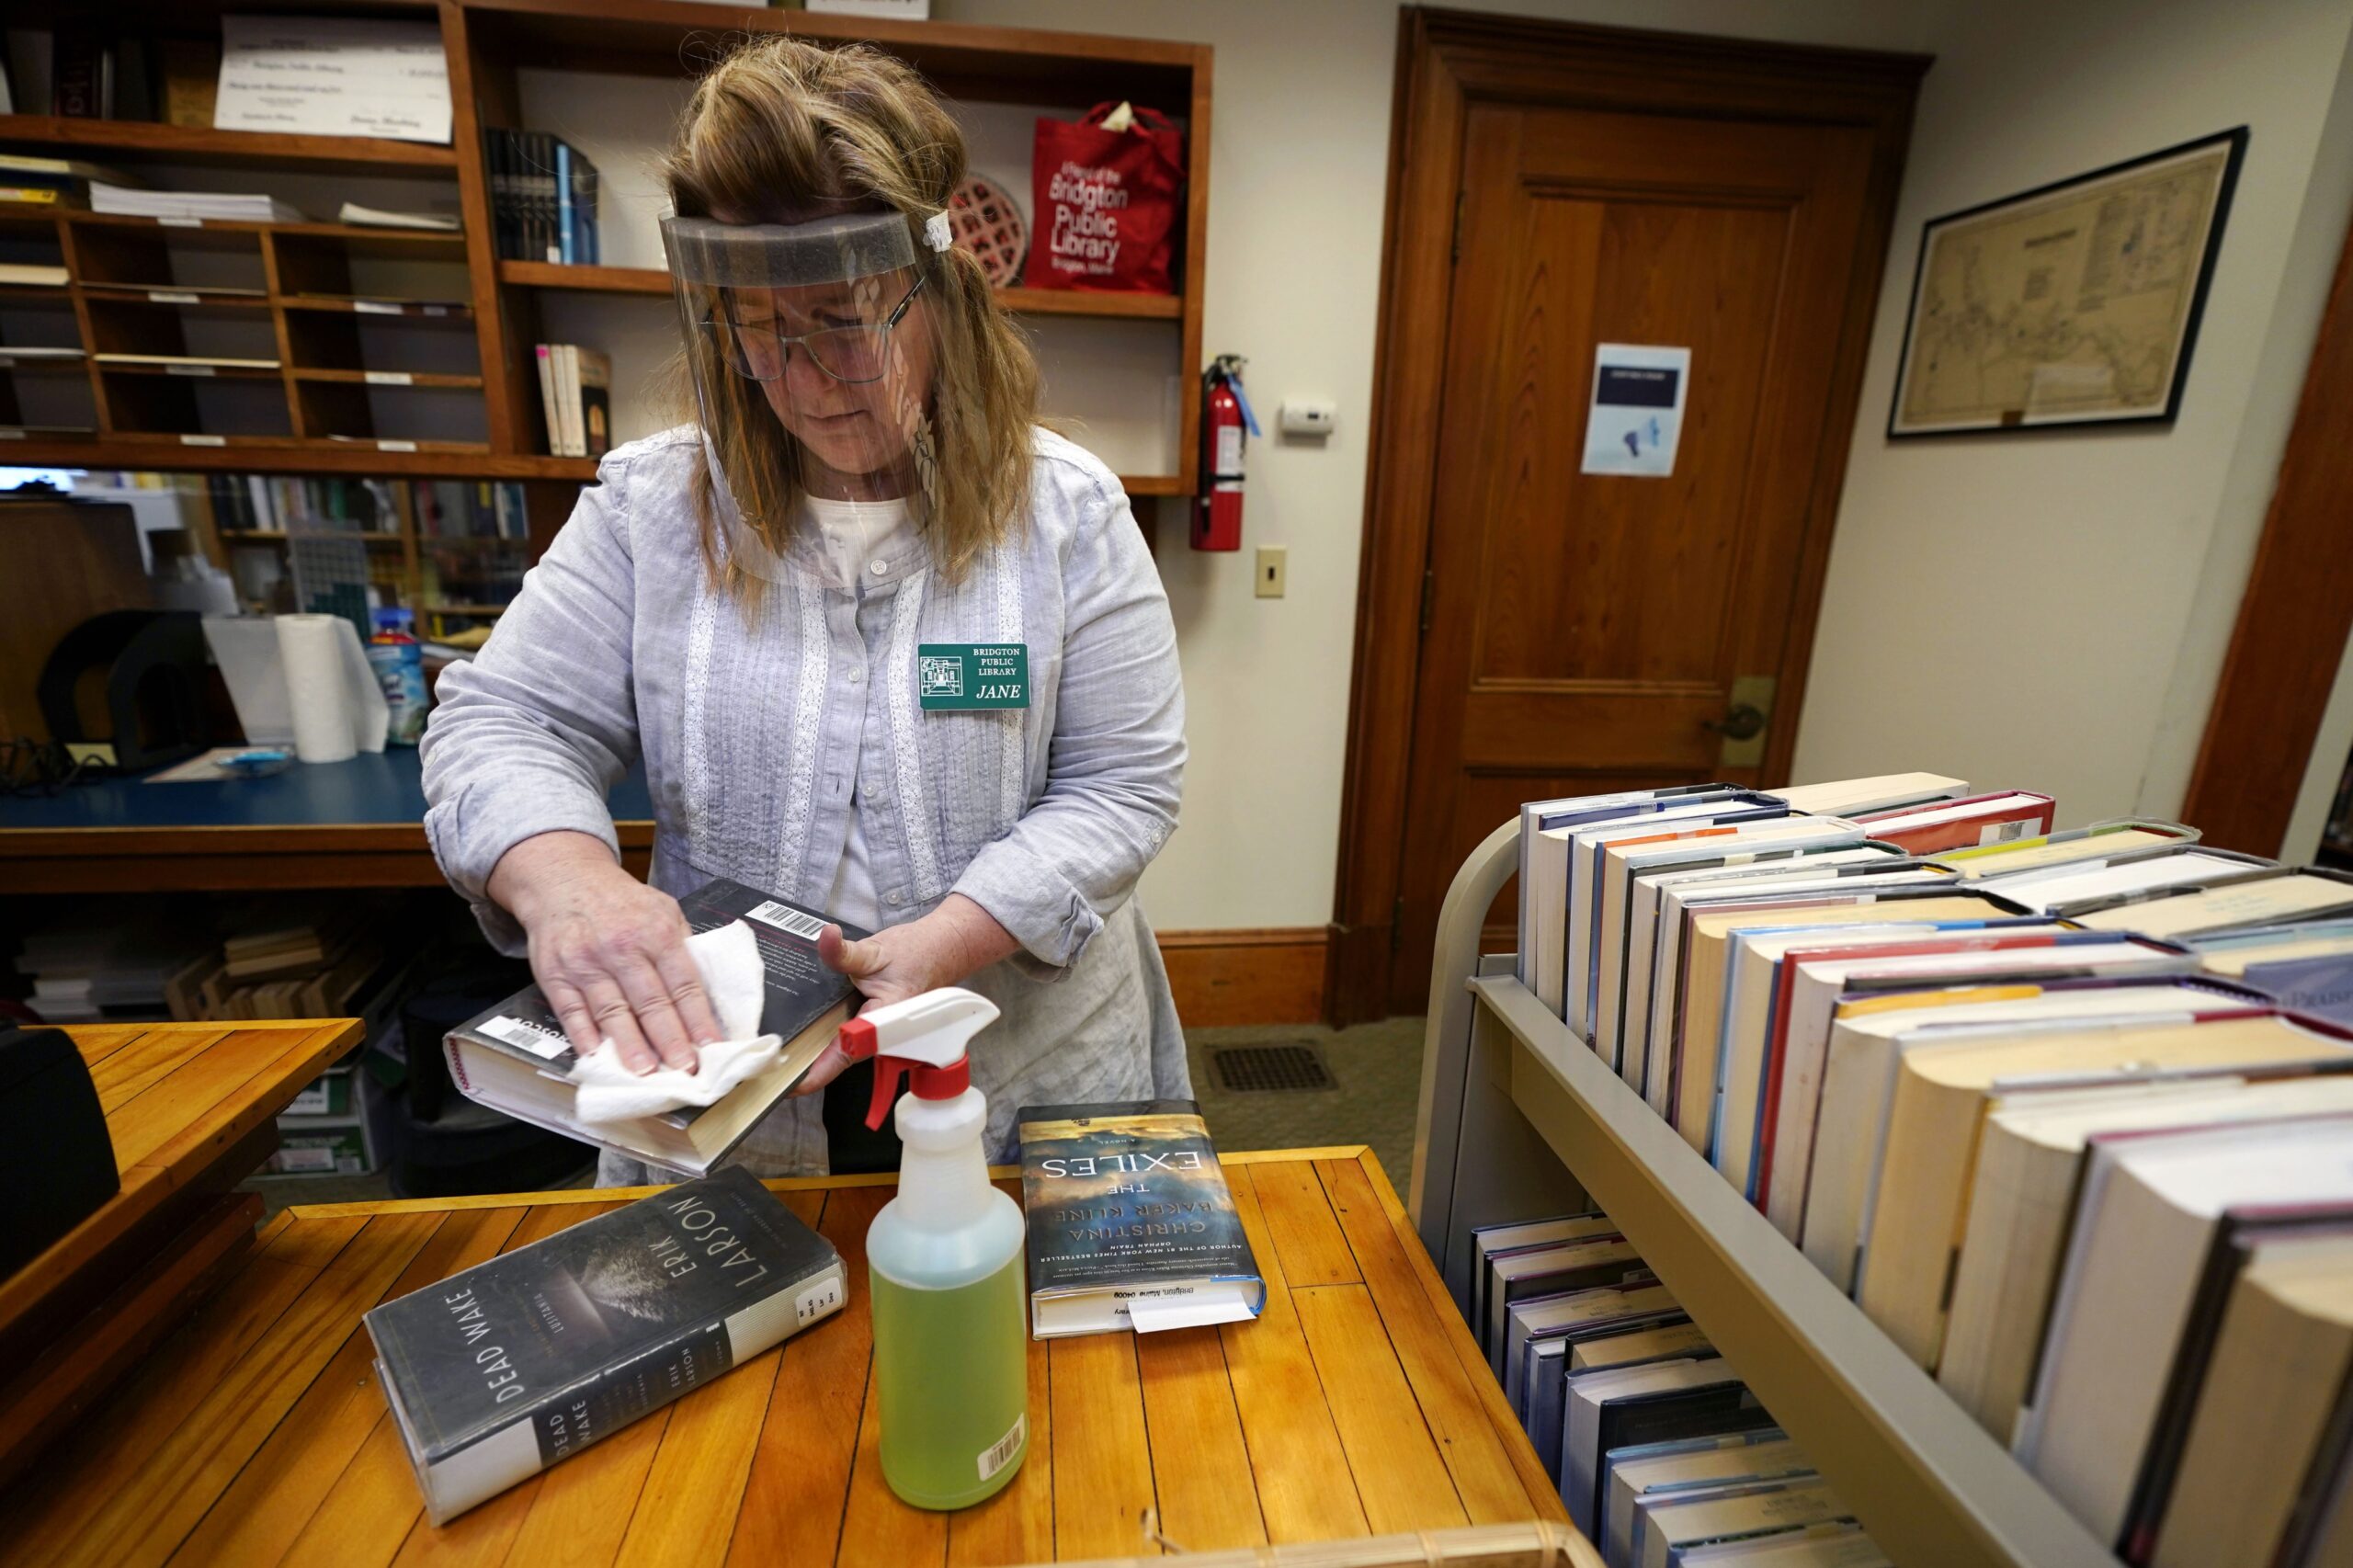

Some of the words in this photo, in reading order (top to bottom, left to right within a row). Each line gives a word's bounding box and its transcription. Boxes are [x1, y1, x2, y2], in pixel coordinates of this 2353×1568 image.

[1049, 173, 1128, 213] Bridgton
[1055, 204, 1117, 238] Public
[1050, 226, 1120, 266] Library
[973, 648, 1019, 656] BRIDGTON
[978, 668, 1017, 676] LIBRARY
[976, 685, 1021, 699] JANE
[1040, 1151, 1203, 1179] EXILES
[1108, 1183, 1150, 1195] THE
[1055, 1206, 1125, 1222] KLINE
[1134, 1201, 1214, 1218] BAKER
[667, 1195, 768, 1288] LARSON
[1068, 1221, 1206, 1241] CHRISTINA
[1138, 1241, 1172, 1249] ORPHAN
[648, 1234, 697, 1279] ERIK
[1040, 1254, 1091, 1263] BESTSELLER
[445, 1288, 491, 1346] WAKE
[534, 1292, 564, 1334] LUSITANIA
[474, 1346, 526, 1403] DEAD
[551, 1414, 569, 1458] DEAD
[572, 1399, 593, 1445] WAKE
